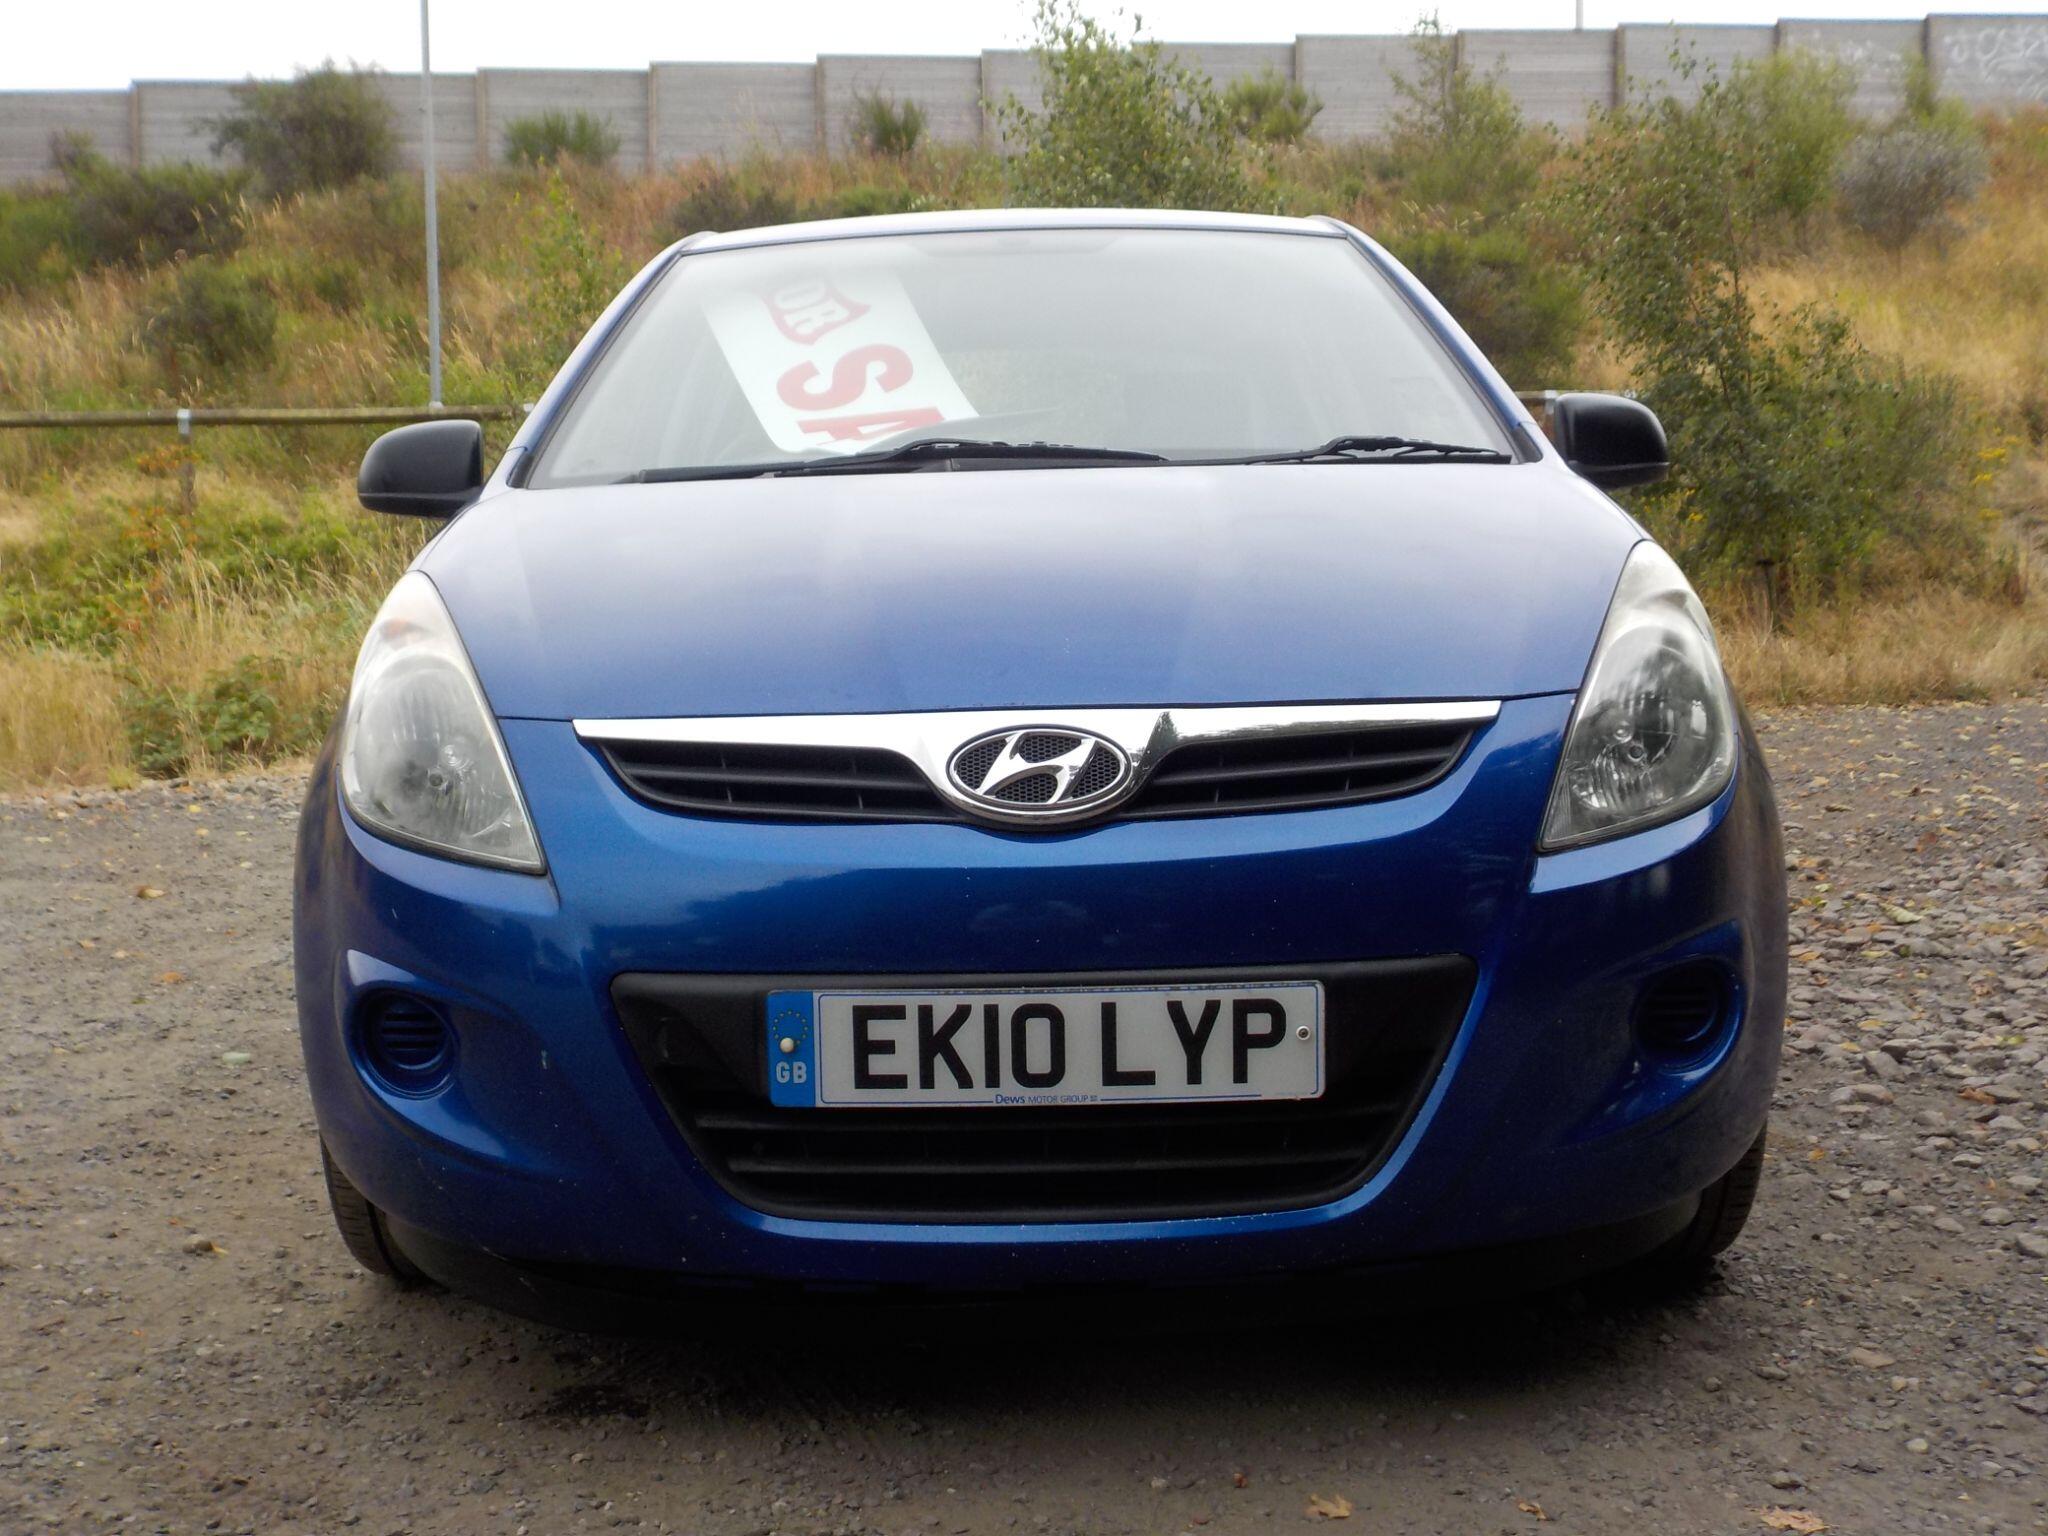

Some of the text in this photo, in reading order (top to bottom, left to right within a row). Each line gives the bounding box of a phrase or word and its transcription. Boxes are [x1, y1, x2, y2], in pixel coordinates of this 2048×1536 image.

[851, 998, 1287, 1090] EK10 LYP
[775, 1061, 807, 1084] GB
[995, 1094, 1025, 1104] Dews
[1028, 1095, 1058, 1104] MOTOR
[1060, 1094, 1089, 1103] GROUP
